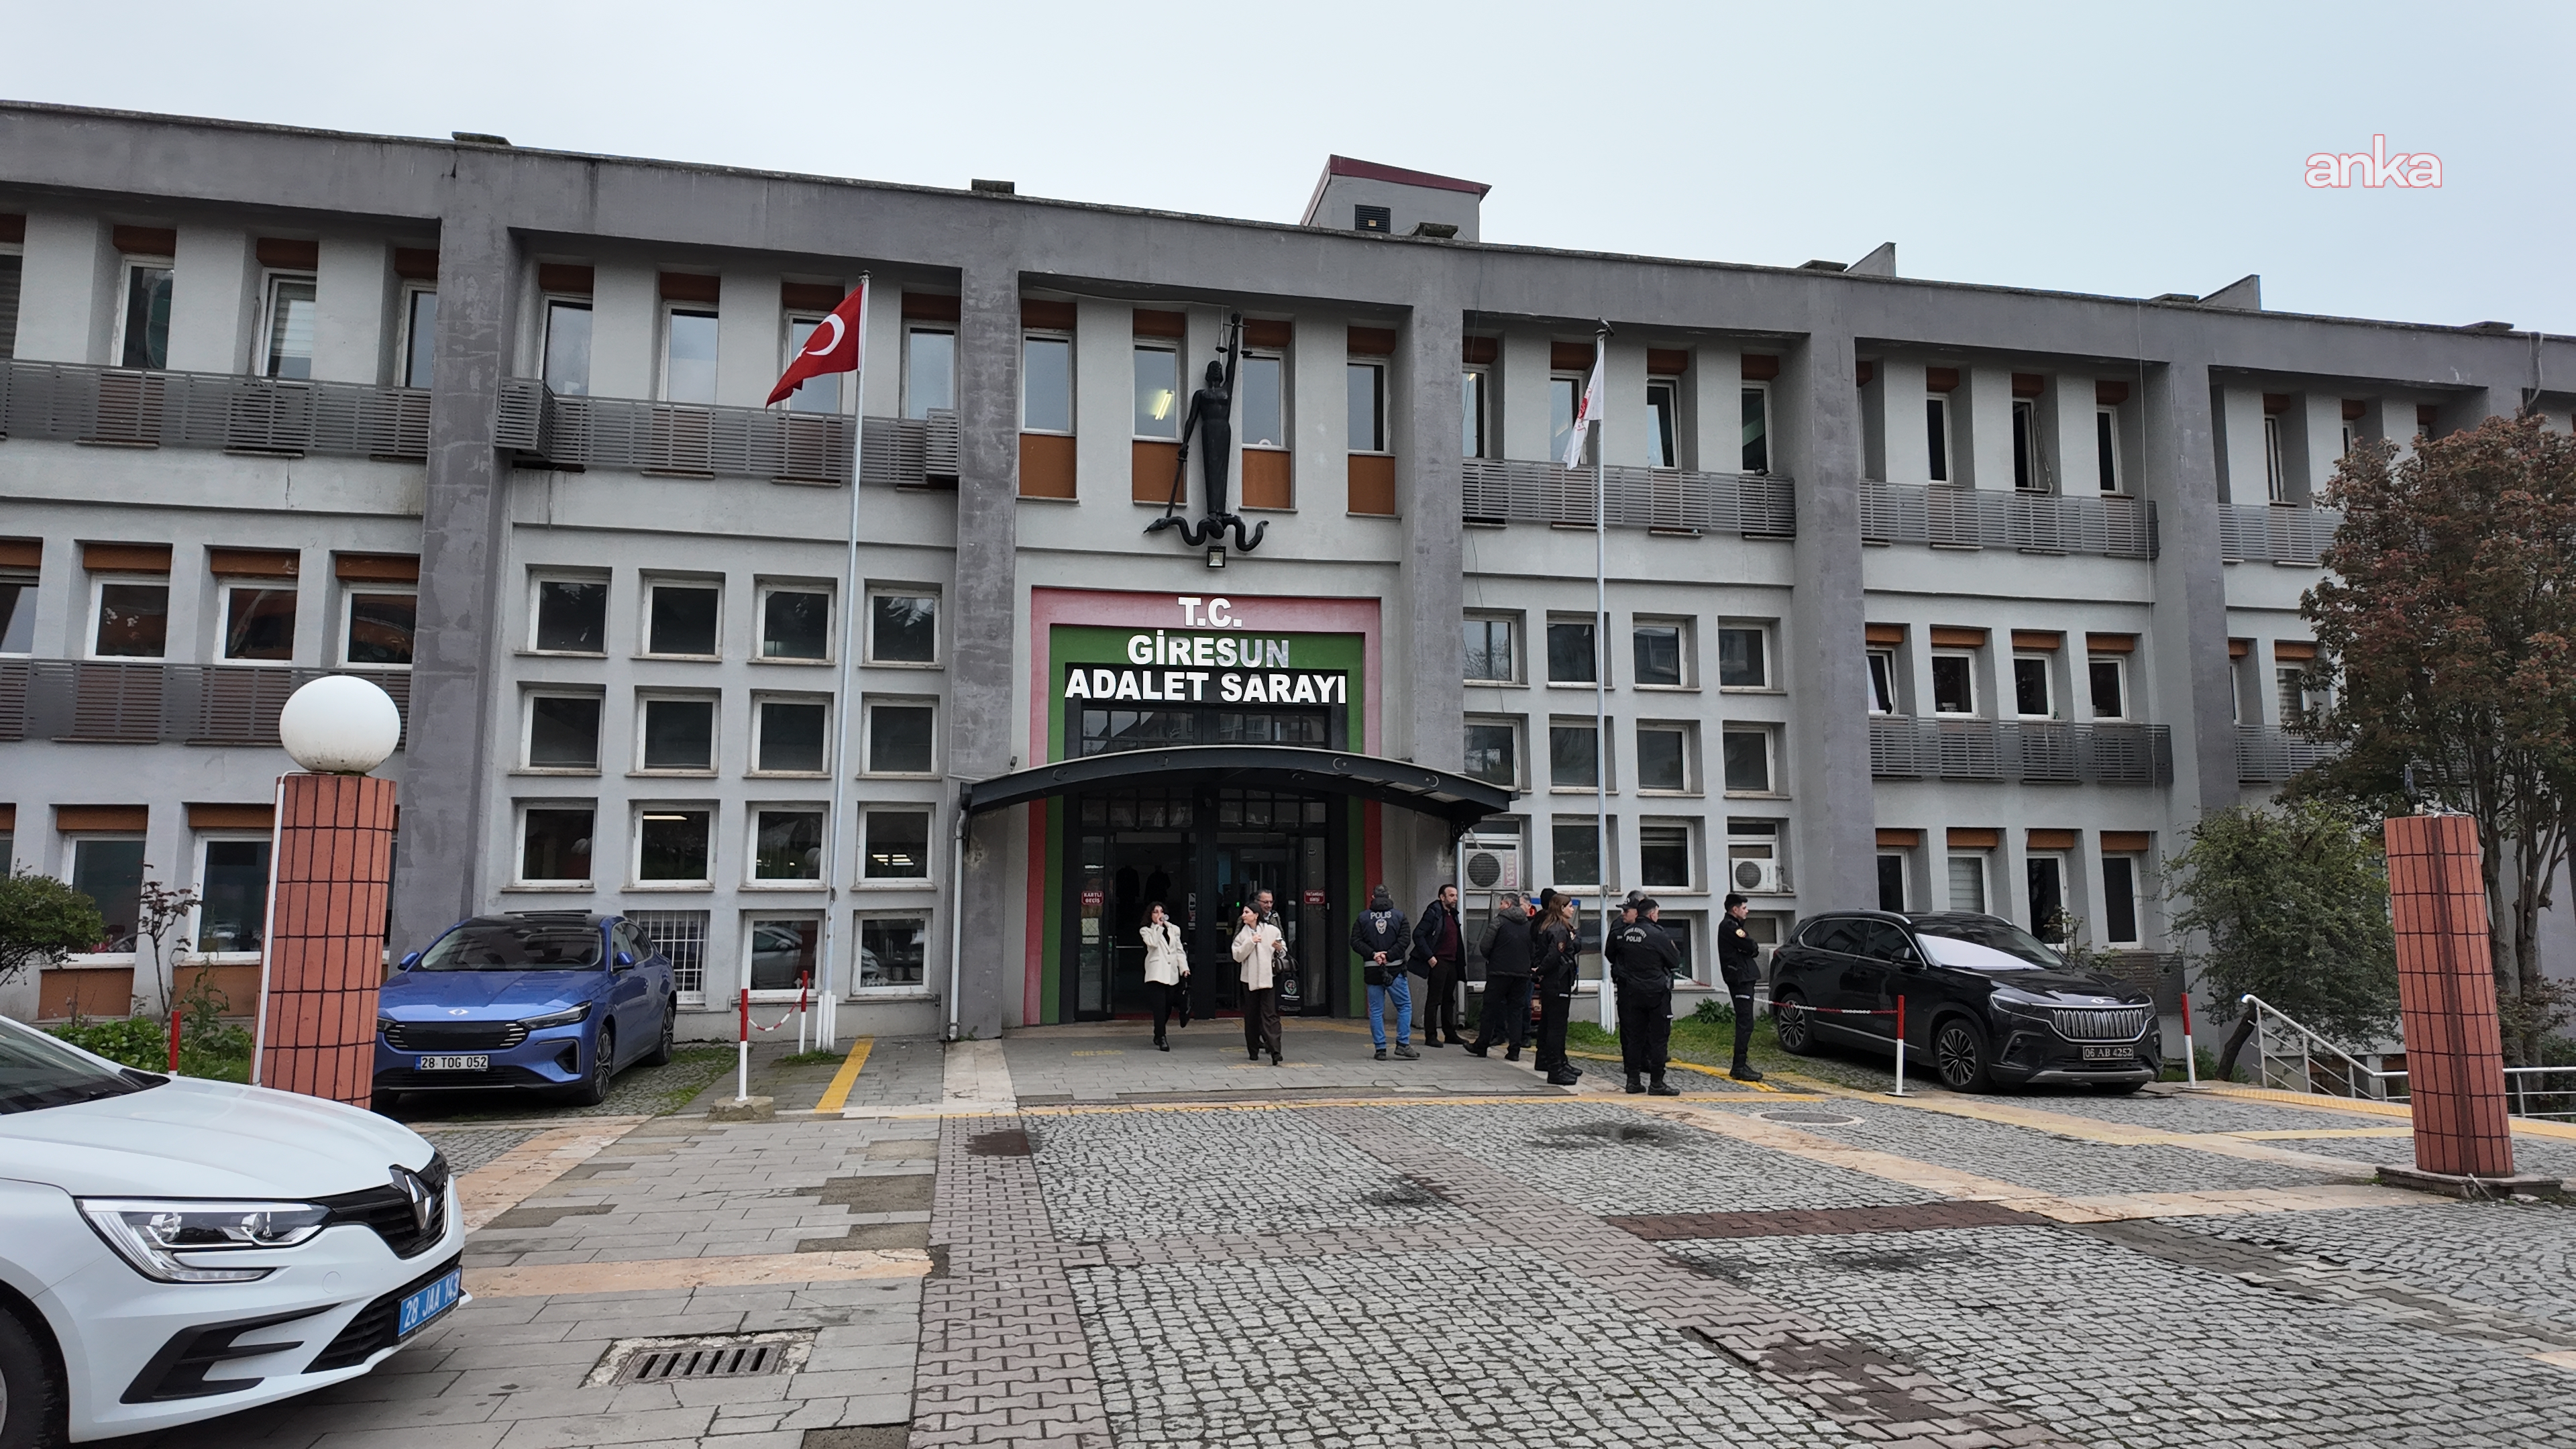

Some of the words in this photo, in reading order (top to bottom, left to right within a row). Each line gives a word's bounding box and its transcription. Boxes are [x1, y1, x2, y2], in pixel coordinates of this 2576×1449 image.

[1179, 597, 1242, 627] T.C.
[1128, 630, 1289, 668] GİRESUN
[1065, 669, 1208, 701] ADALET
[1221, 673, 1346, 704] SARAYI
[422, 1058, 435, 1068] 28
[441, 1057, 461, 1067] TOG
[467, 1057, 486, 1067] 052
[2085, 1049, 2095, 1057] 06
[2098, 1049, 2110, 1057] AB
[2112, 1048, 2132, 1057] 4252
[405, 1297, 419, 1328] 28
[423, 1284, 440, 1317] JAA
[445, 1273, 459, 1303] 143
